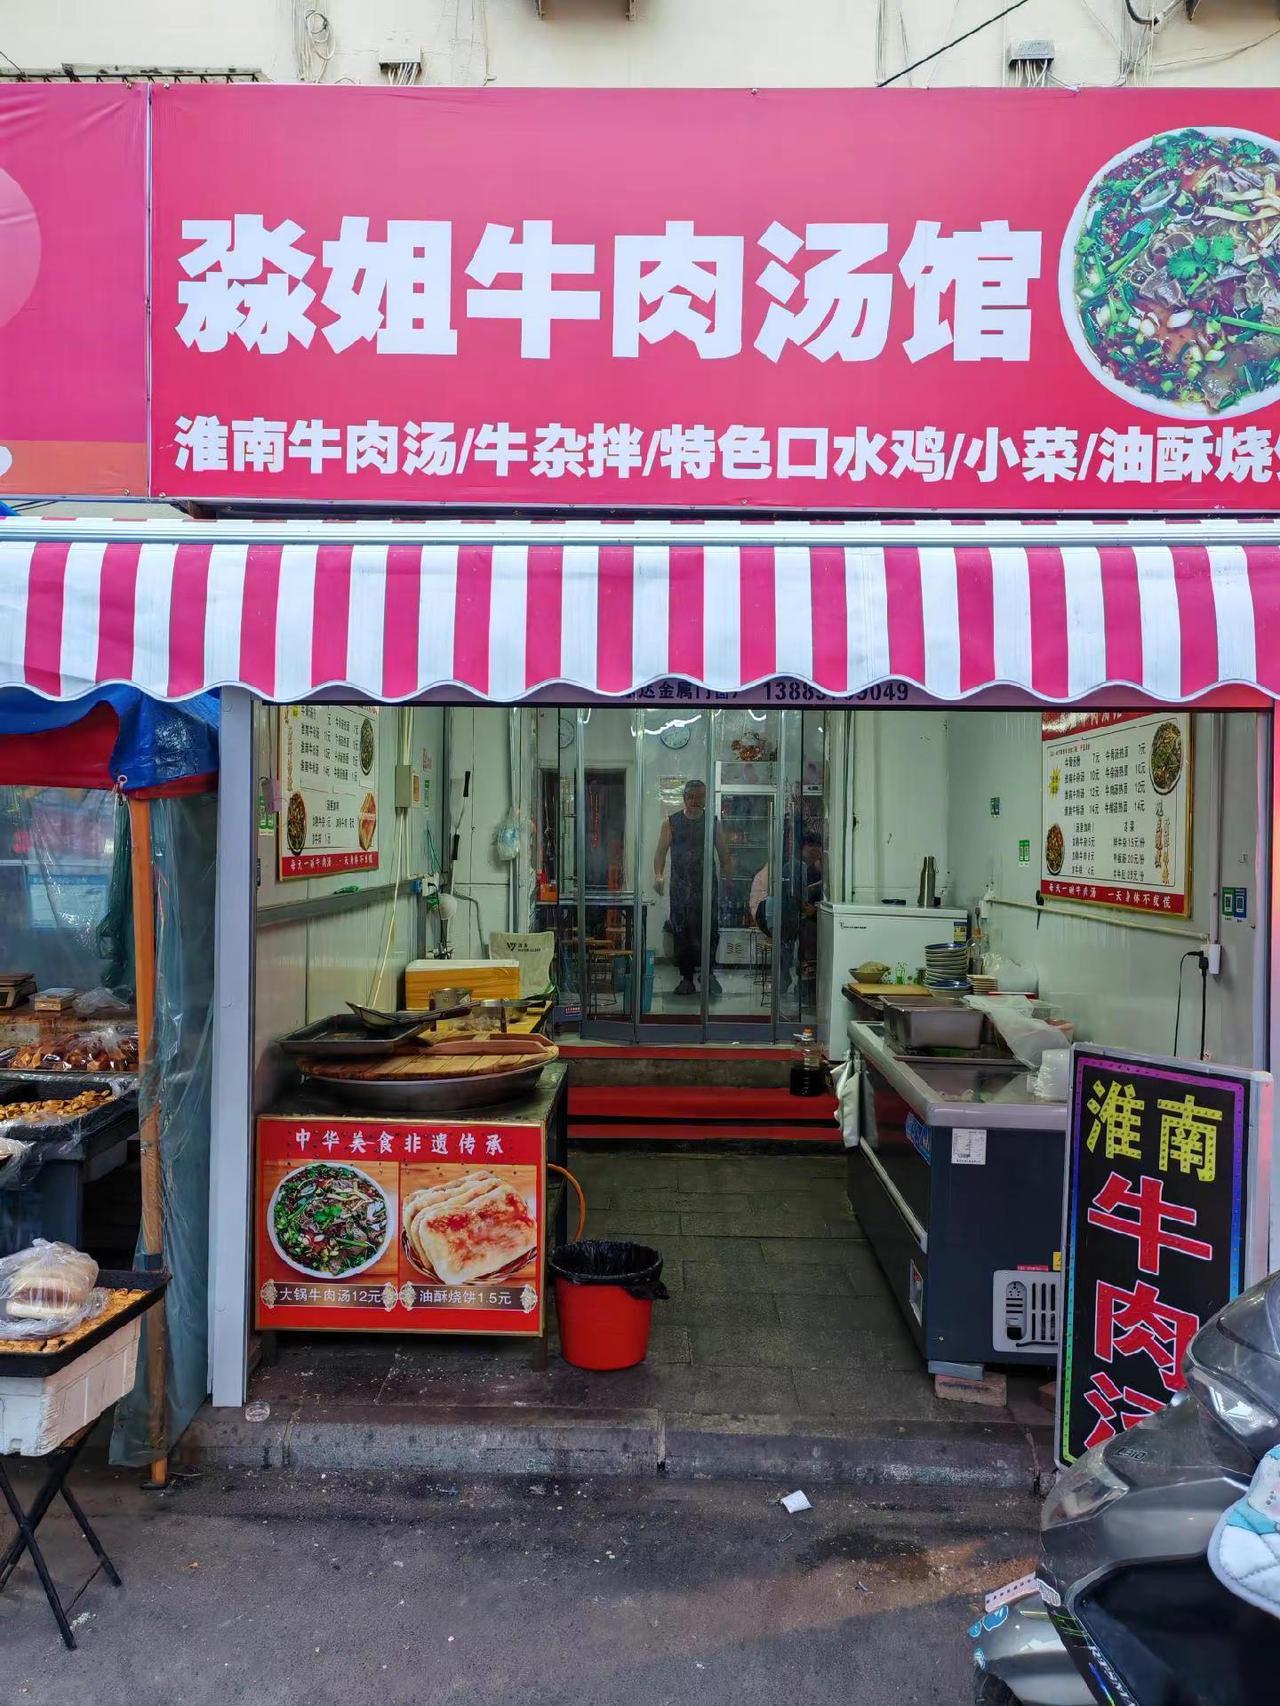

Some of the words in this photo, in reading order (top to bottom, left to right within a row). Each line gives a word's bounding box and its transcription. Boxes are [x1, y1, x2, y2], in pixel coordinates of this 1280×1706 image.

[176, 214, 1043, 363] 淼姐牛肉汤馆
[174, 415, 1280, 484] 淮南牛肉汤/牛杂拌/特色口水鸡/小菜/油酥烧
[295, 1128, 504, 1155] 中华美食非遗传承
[1086, 1080, 1223, 1182] 淮南
[280, 1287, 382, 1303] 大锅牛肉汤12元
